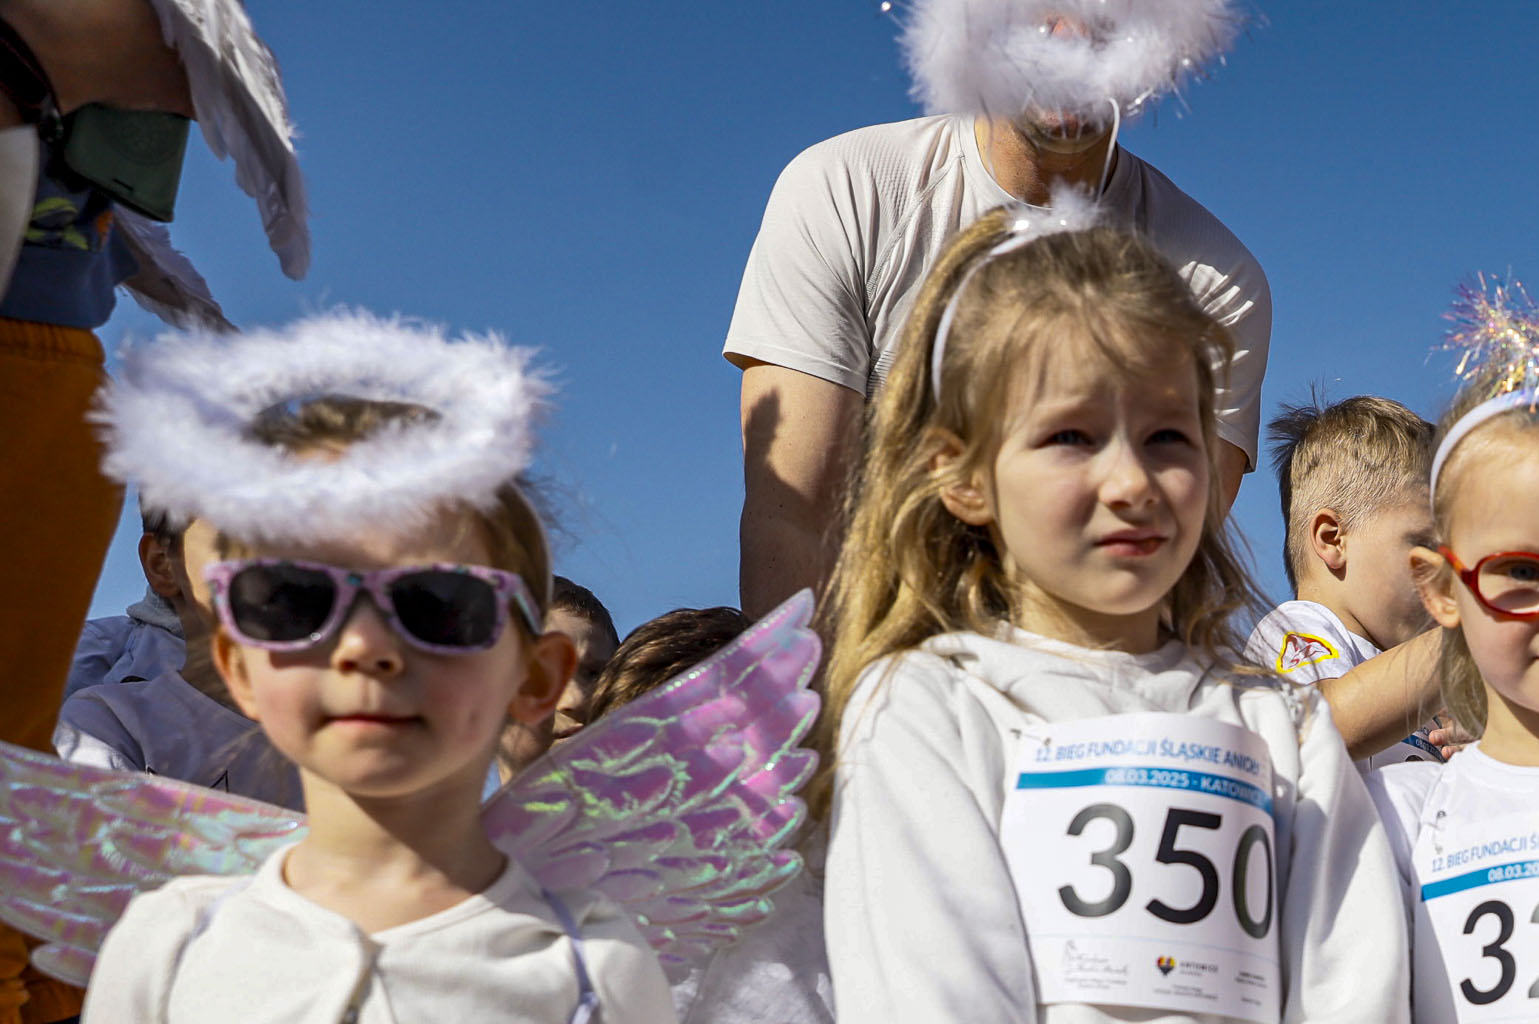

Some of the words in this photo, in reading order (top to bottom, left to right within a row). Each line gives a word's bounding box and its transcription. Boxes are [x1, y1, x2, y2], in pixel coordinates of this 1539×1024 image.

[1055, 743, 1086, 760] BIEG
[1160, 737, 1221, 764] ŚLĄSKIE
[1104, 769, 1190, 788] 08.03.2025
[1058, 802, 1273, 940] 350
[1432, 858, 1445, 873] 12.
[1446, 850, 1469, 868] BIEG
[1470, 839, 1528, 861] FUNDACJI
